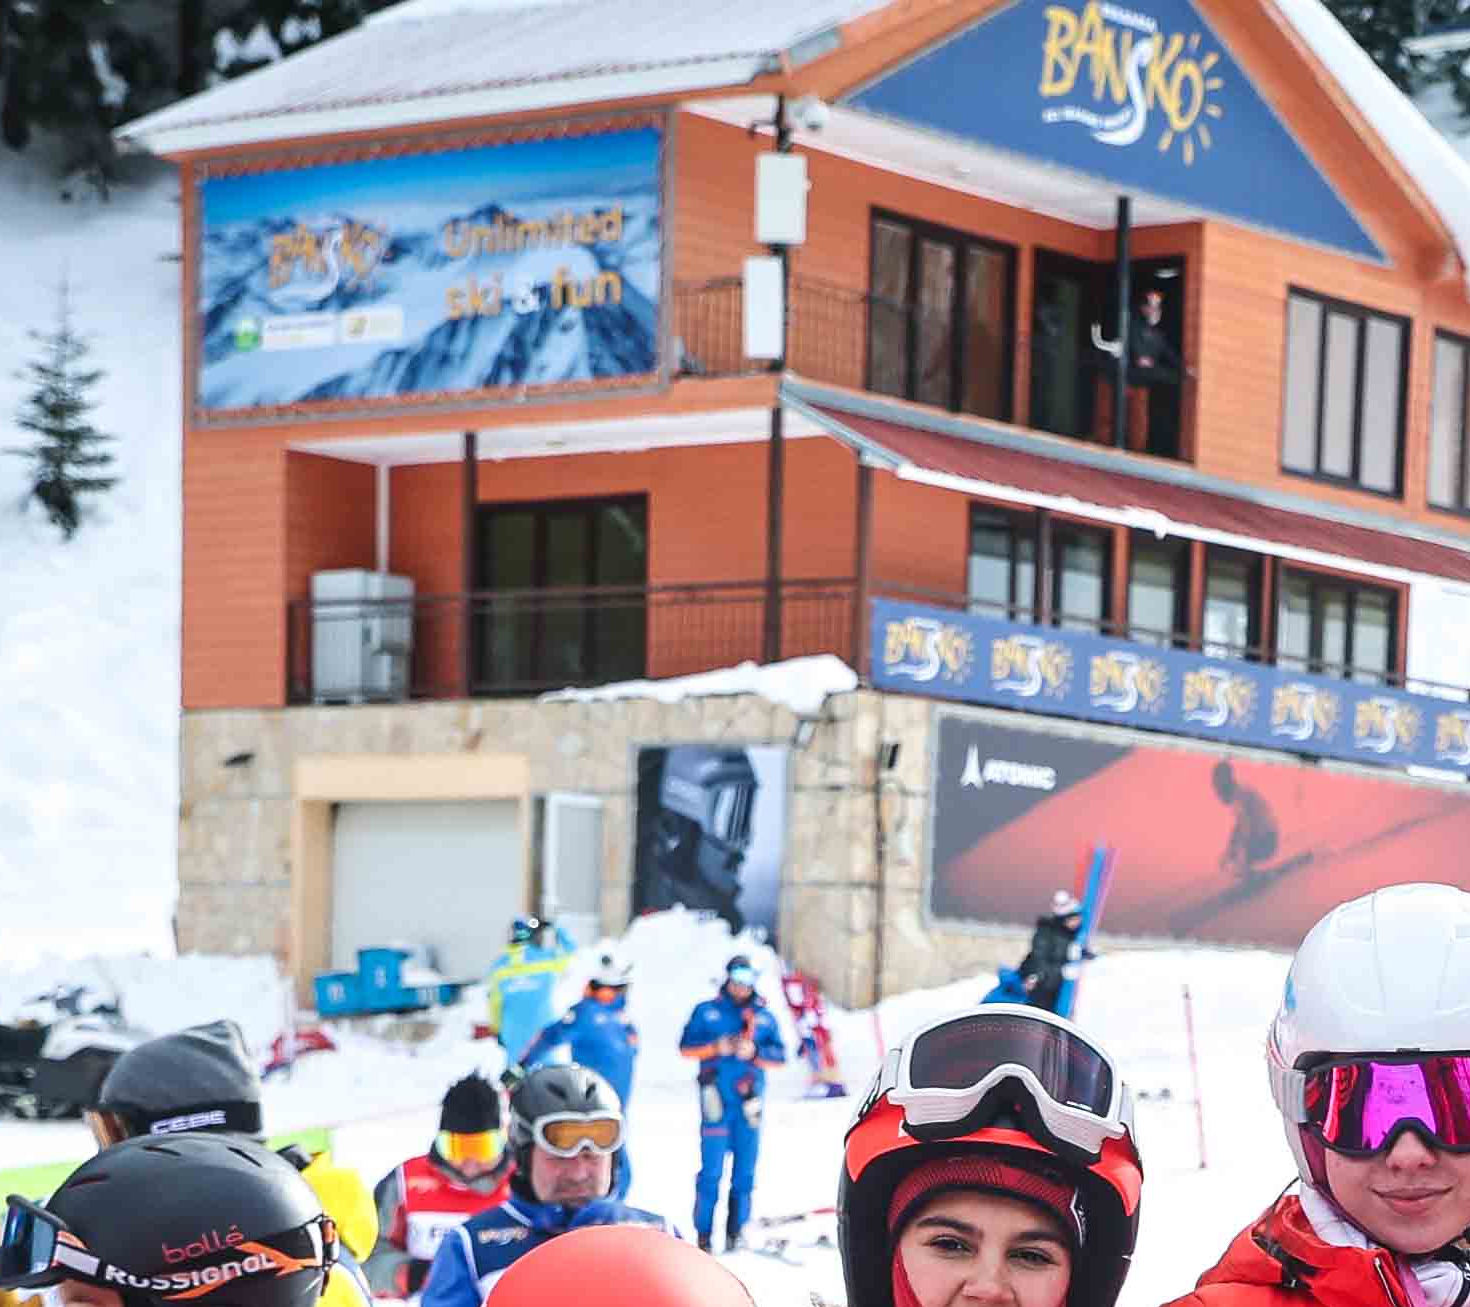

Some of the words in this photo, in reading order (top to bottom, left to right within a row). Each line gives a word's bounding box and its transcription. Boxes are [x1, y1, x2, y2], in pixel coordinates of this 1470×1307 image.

[1040, 3, 1202, 142] BANSKO
[444, 207, 623, 260] Unlimited
[444, 274, 501, 318] ski
[512, 284, 540, 313] &
[549, 265, 621, 310] fun
[161, 1223, 245, 1264] bollé
